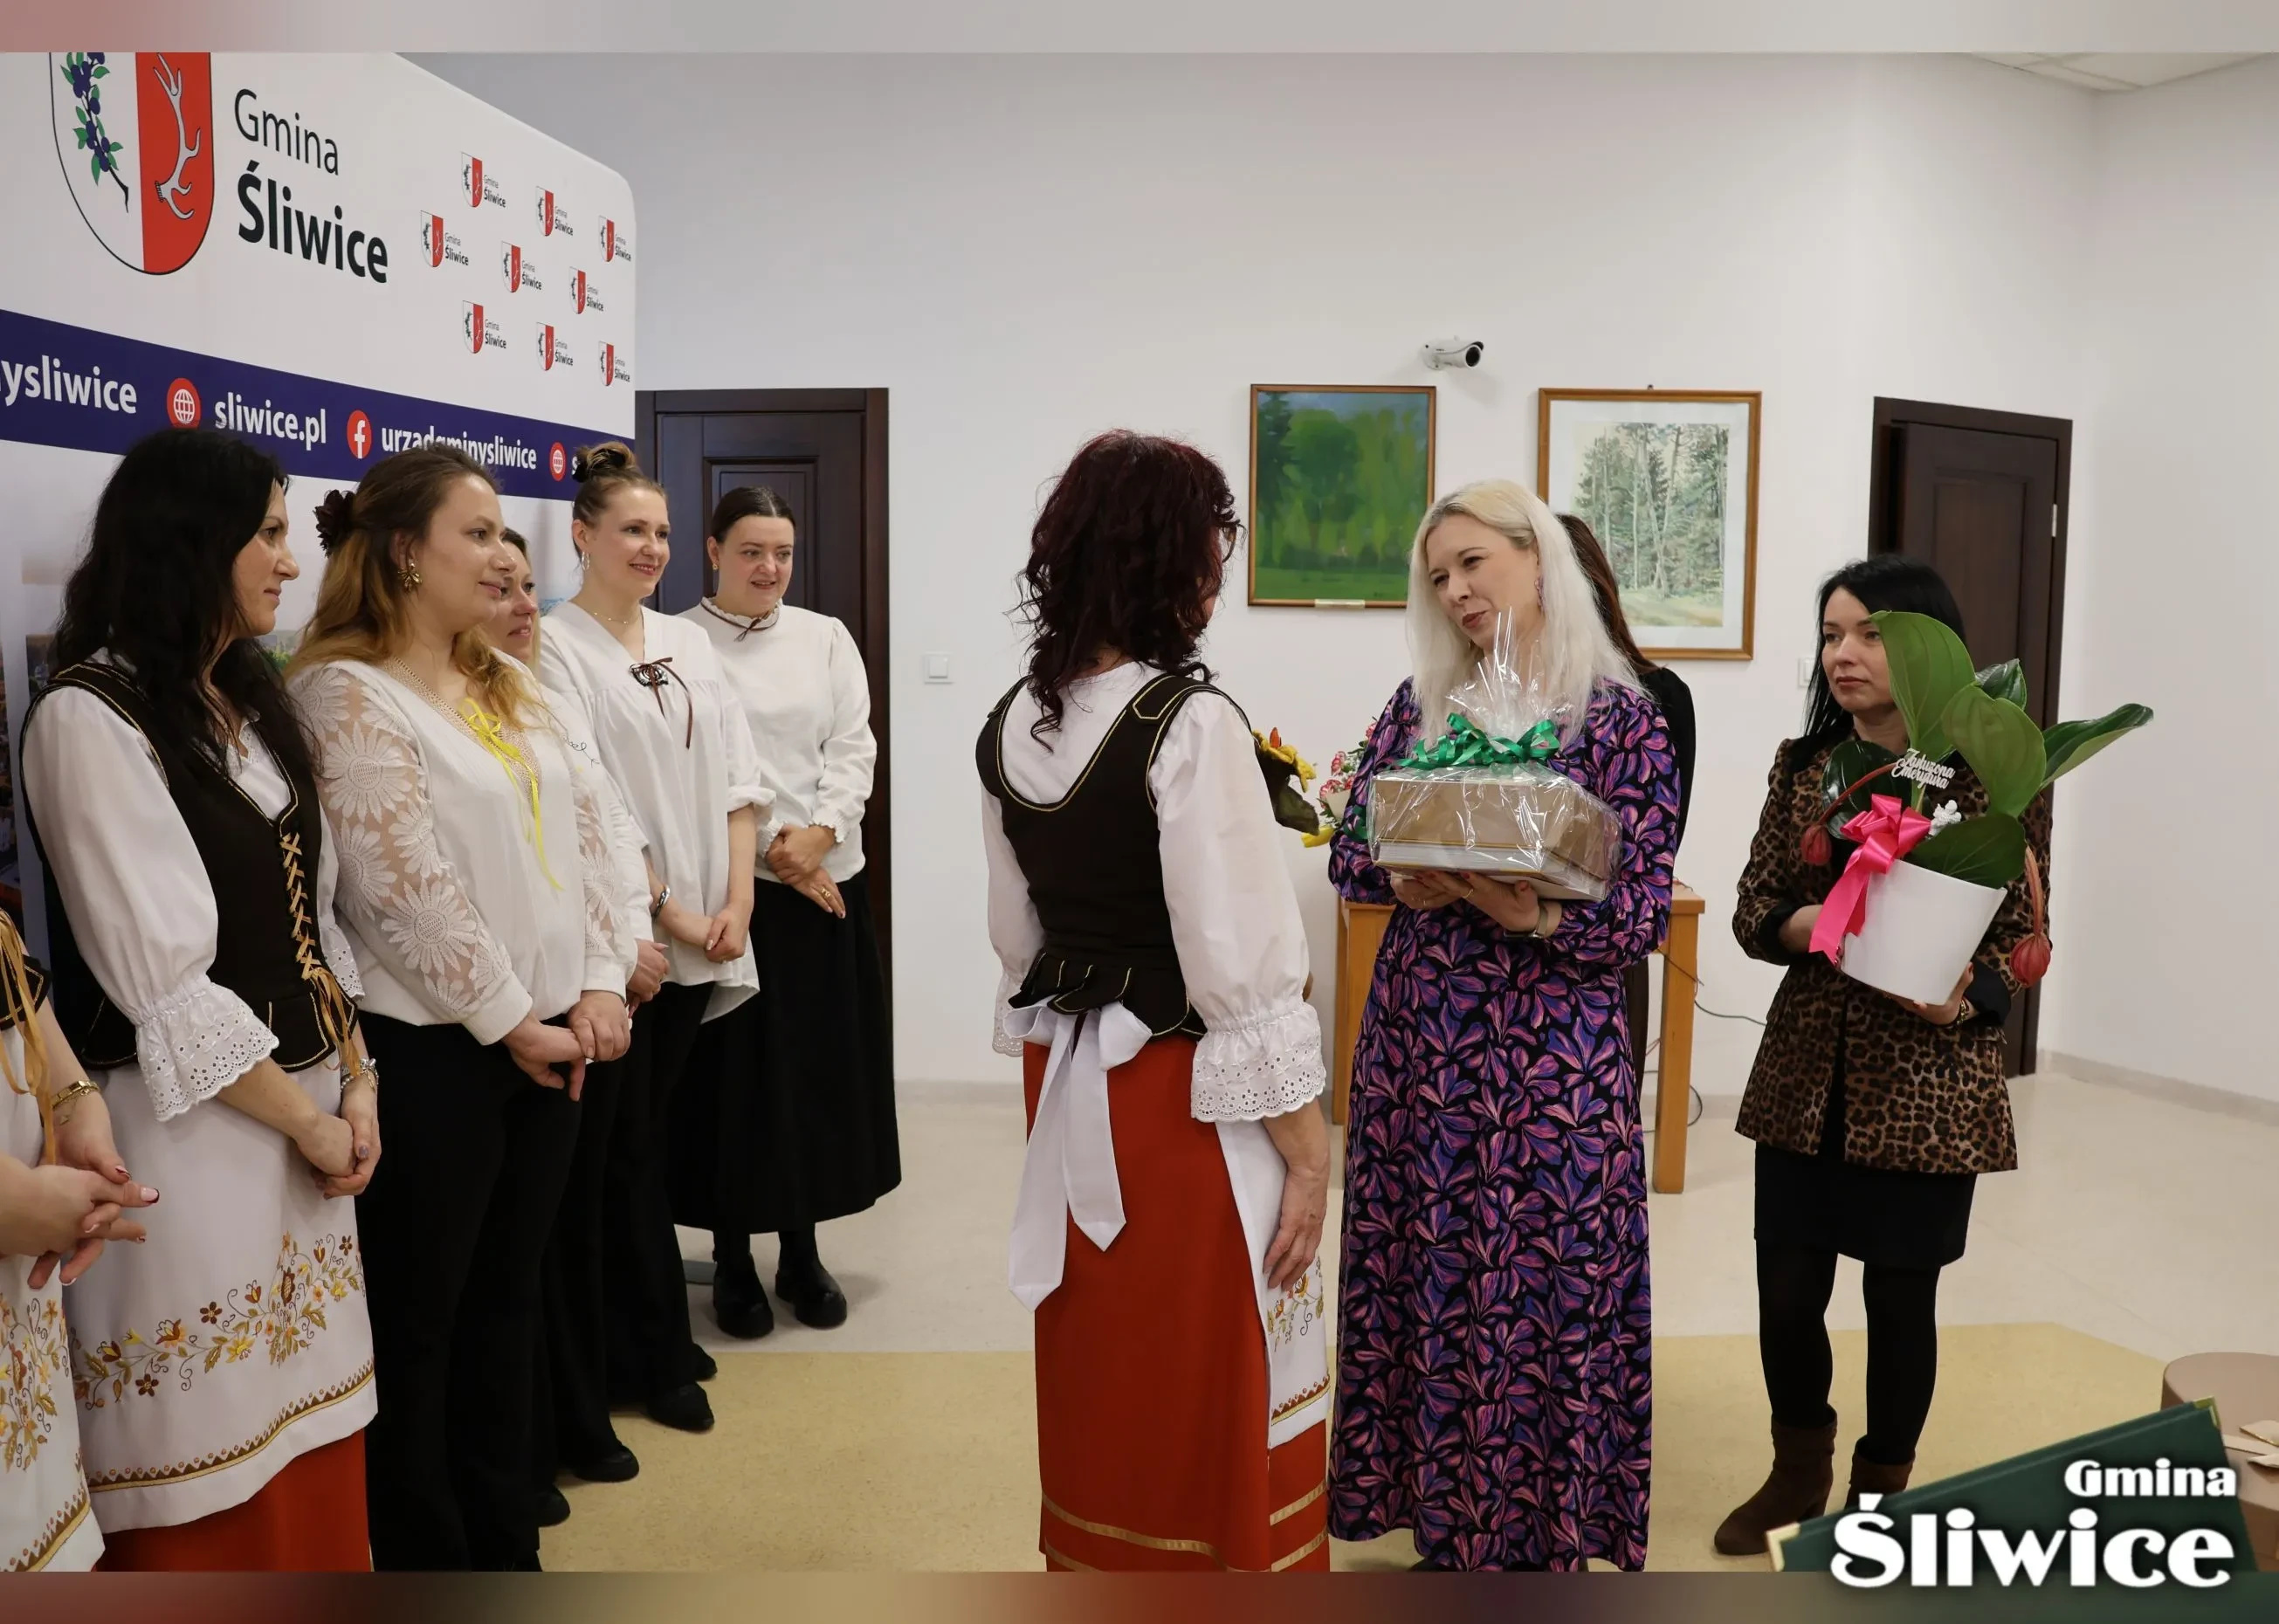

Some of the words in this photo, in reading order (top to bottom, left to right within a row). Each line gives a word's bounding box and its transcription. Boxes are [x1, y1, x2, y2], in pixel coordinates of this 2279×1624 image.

[234, 88, 339, 175] Gmina
[238, 159, 388, 284] Śliwice
[444, 244, 469, 265] Śliwice
[215, 392, 327, 451] sliwice.pl
